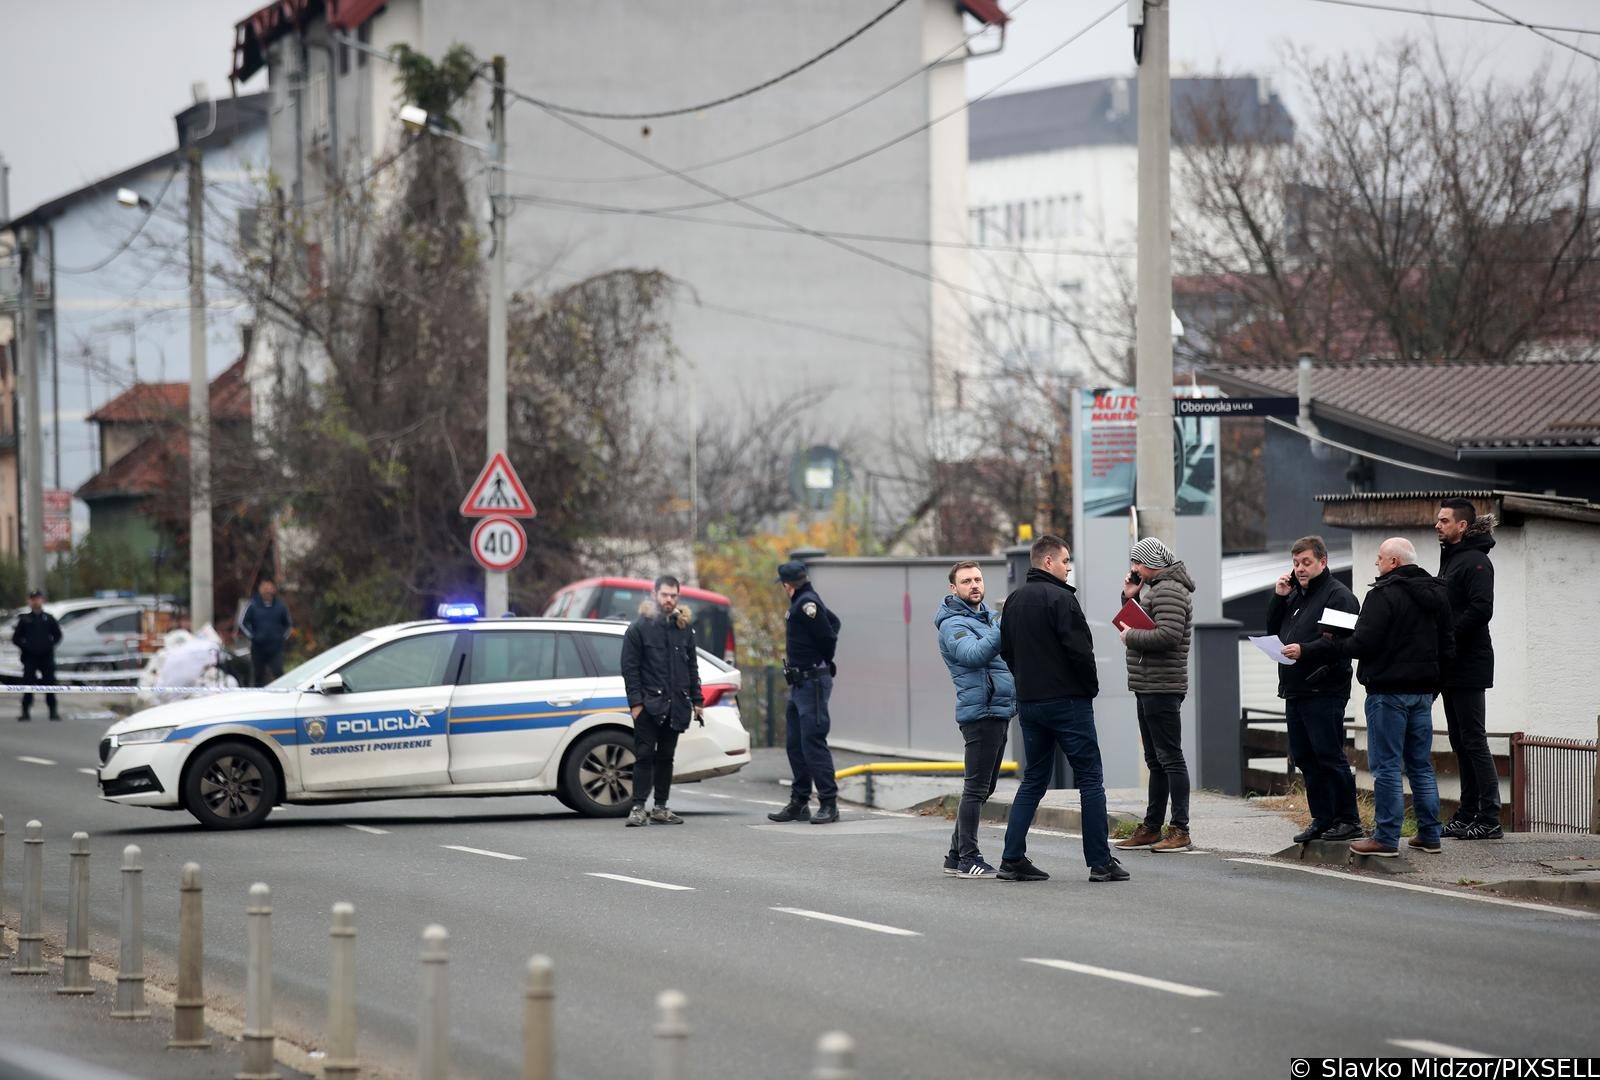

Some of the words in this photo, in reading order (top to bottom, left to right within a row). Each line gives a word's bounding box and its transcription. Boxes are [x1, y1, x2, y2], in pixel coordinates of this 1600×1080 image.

[1181, 401, 1231, 413] Oborovska
[1232, 402, 1254, 411] ULICA
[484, 530, 513, 556] 40
[336, 714, 431, 735] POLICIJA
[310, 743, 366, 756] SIGURNOST
[373, 739, 433, 752] POVJERENJE
